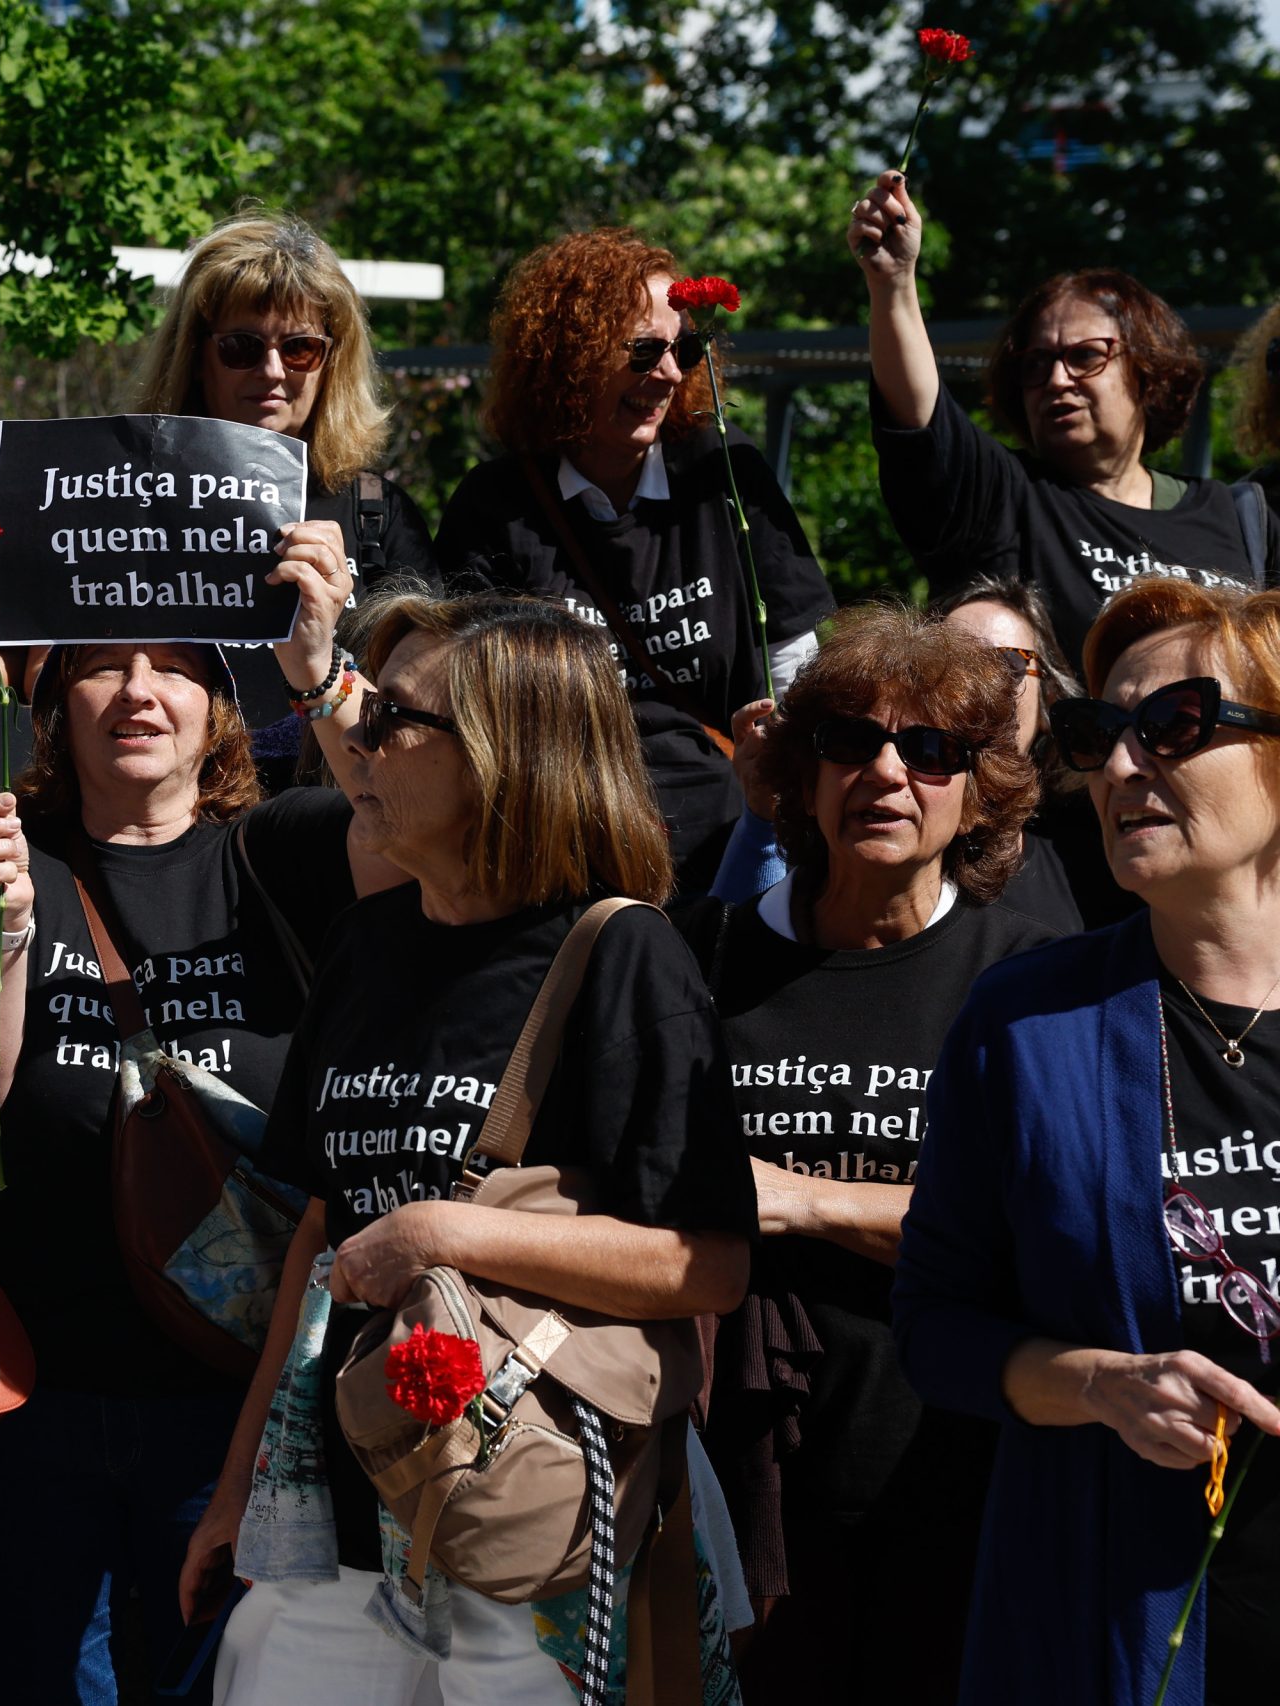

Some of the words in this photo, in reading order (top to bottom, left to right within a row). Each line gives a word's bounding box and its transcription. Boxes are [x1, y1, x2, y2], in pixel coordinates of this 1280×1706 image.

[39, 462, 177, 511] Justiça
[189, 471, 282, 509] para
[51, 527, 170, 564] quem
[181, 516, 270, 554] nela
[70, 570, 255, 608] trabalha!
[646, 576, 714, 624] para
[644, 617, 712, 656] nela
[44, 941, 157, 995] Jusça
[166, 952, 245, 985] para
[48, 991, 154, 1028] que
[161, 991, 246, 1026] nela
[316, 1062, 420, 1112] Justiça
[424, 1074, 497, 1110] par
[731, 1055, 852, 1094] ustiça
[864, 1063, 933, 1097] par
[741, 1110, 835, 1137] uem
[848, 1107, 929, 1142] nel
[324, 1126, 397, 1169] quem
